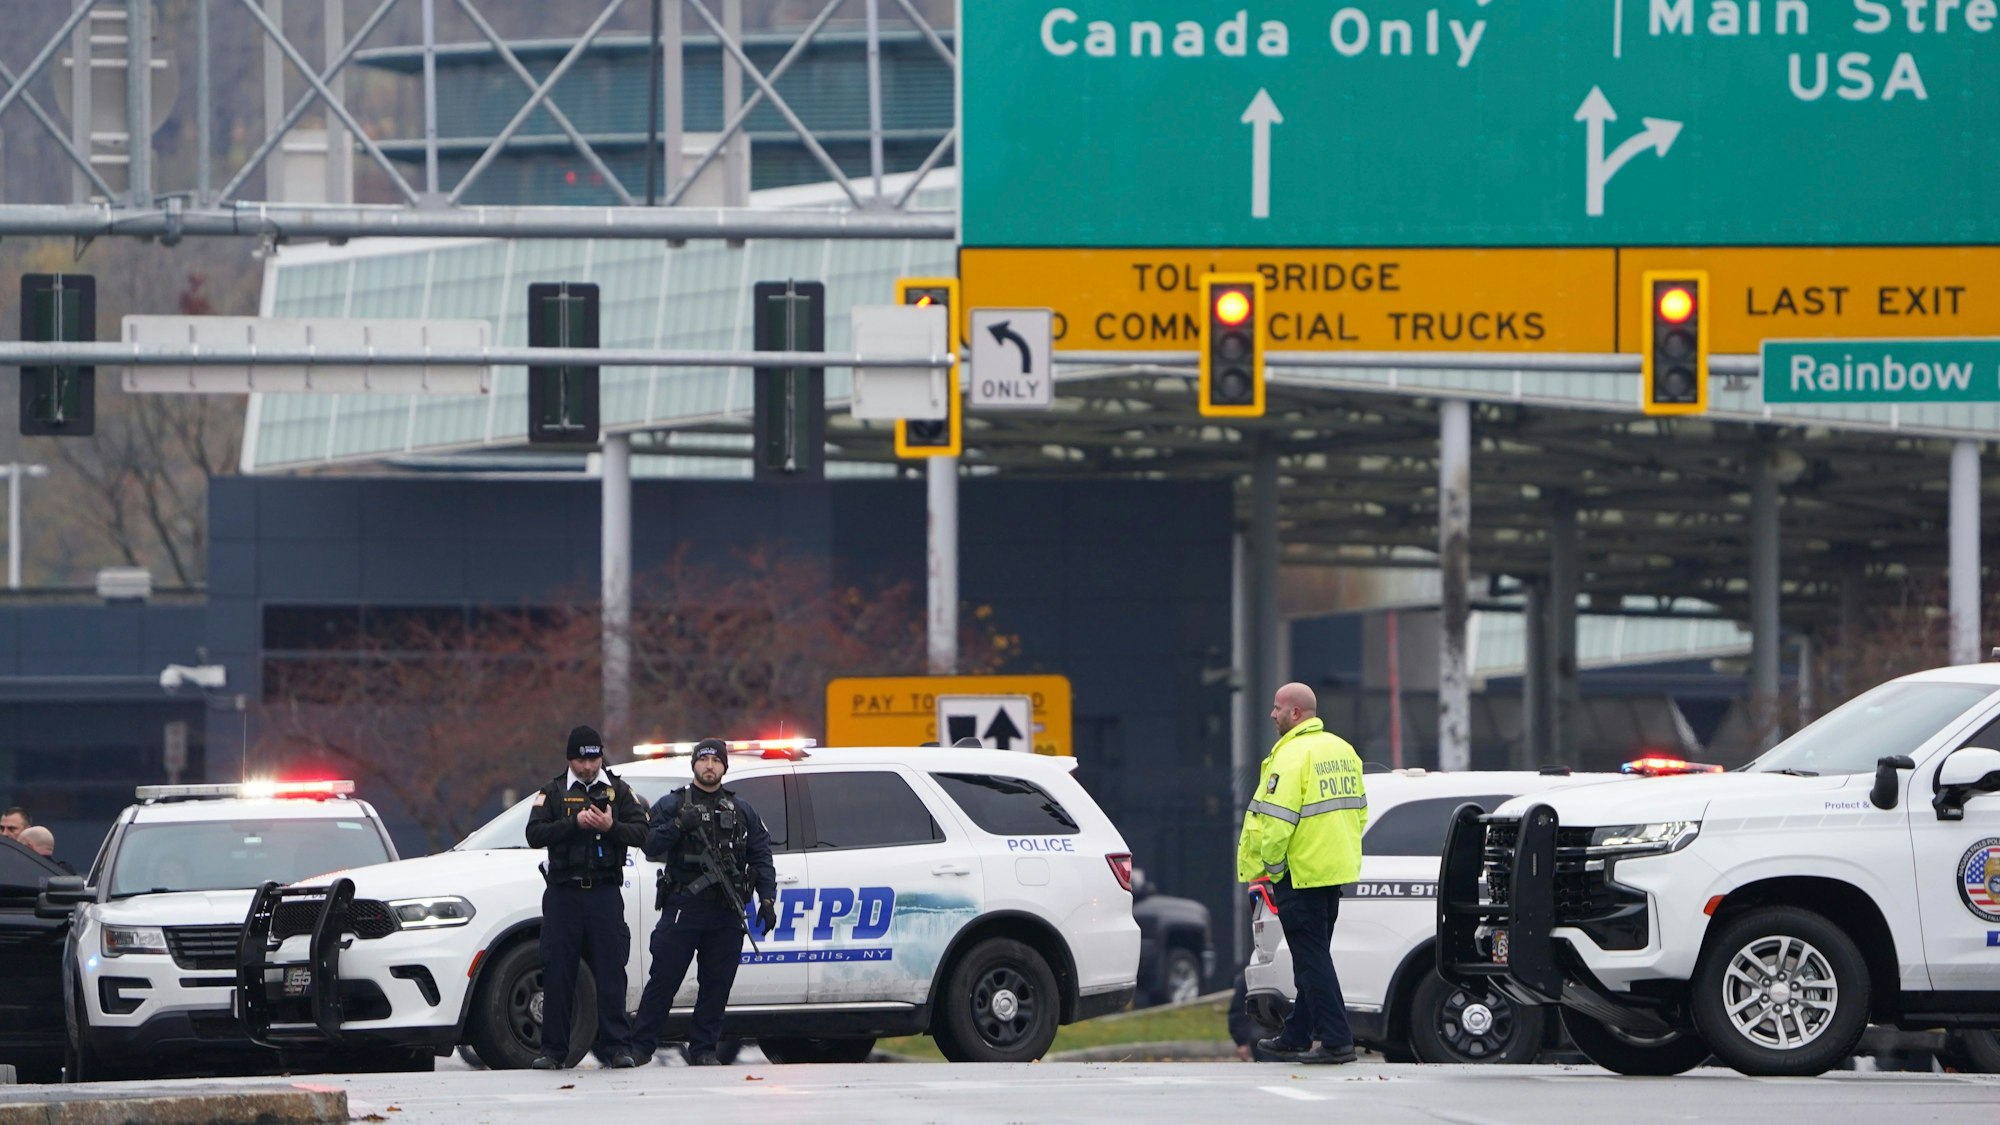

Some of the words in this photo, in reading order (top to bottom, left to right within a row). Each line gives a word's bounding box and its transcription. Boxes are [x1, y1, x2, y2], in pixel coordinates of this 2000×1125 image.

[1649, 0, 1809, 35] Main
[1853, 0, 1998, 33] Stre
[1041, 8, 1289, 56] Canada
[1330, 8, 1486, 67] Only
[1788, 52, 1928, 100] USA
[1132, 263, 1215, 291] TOL
[1257, 263, 1400, 291] BRIDGE
[1747, 286, 1849, 315] LAST
[1878, 286, 1967, 315] EXIT
[1053, 313, 1068, 340] O
[1095, 312, 1359, 340] COMMCIAL
[1387, 312, 1545, 341] TRUCKS
[1790, 354, 1973, 391] Rainbow
[981, 379, 1040, 398] ONLY
[852, 693, 895, 711] PAY
[1825, 801, 1860, 809] Protect
[702, 813, 710, 821] ICE
[1007, 838, 1075, 852] POLICE
[1356, 884, 1404, 896] DIAL
[741, 953, 785, 963] gara
[797, 951, 850, 960] Falls,
[863, 949, 887, 958] NY
